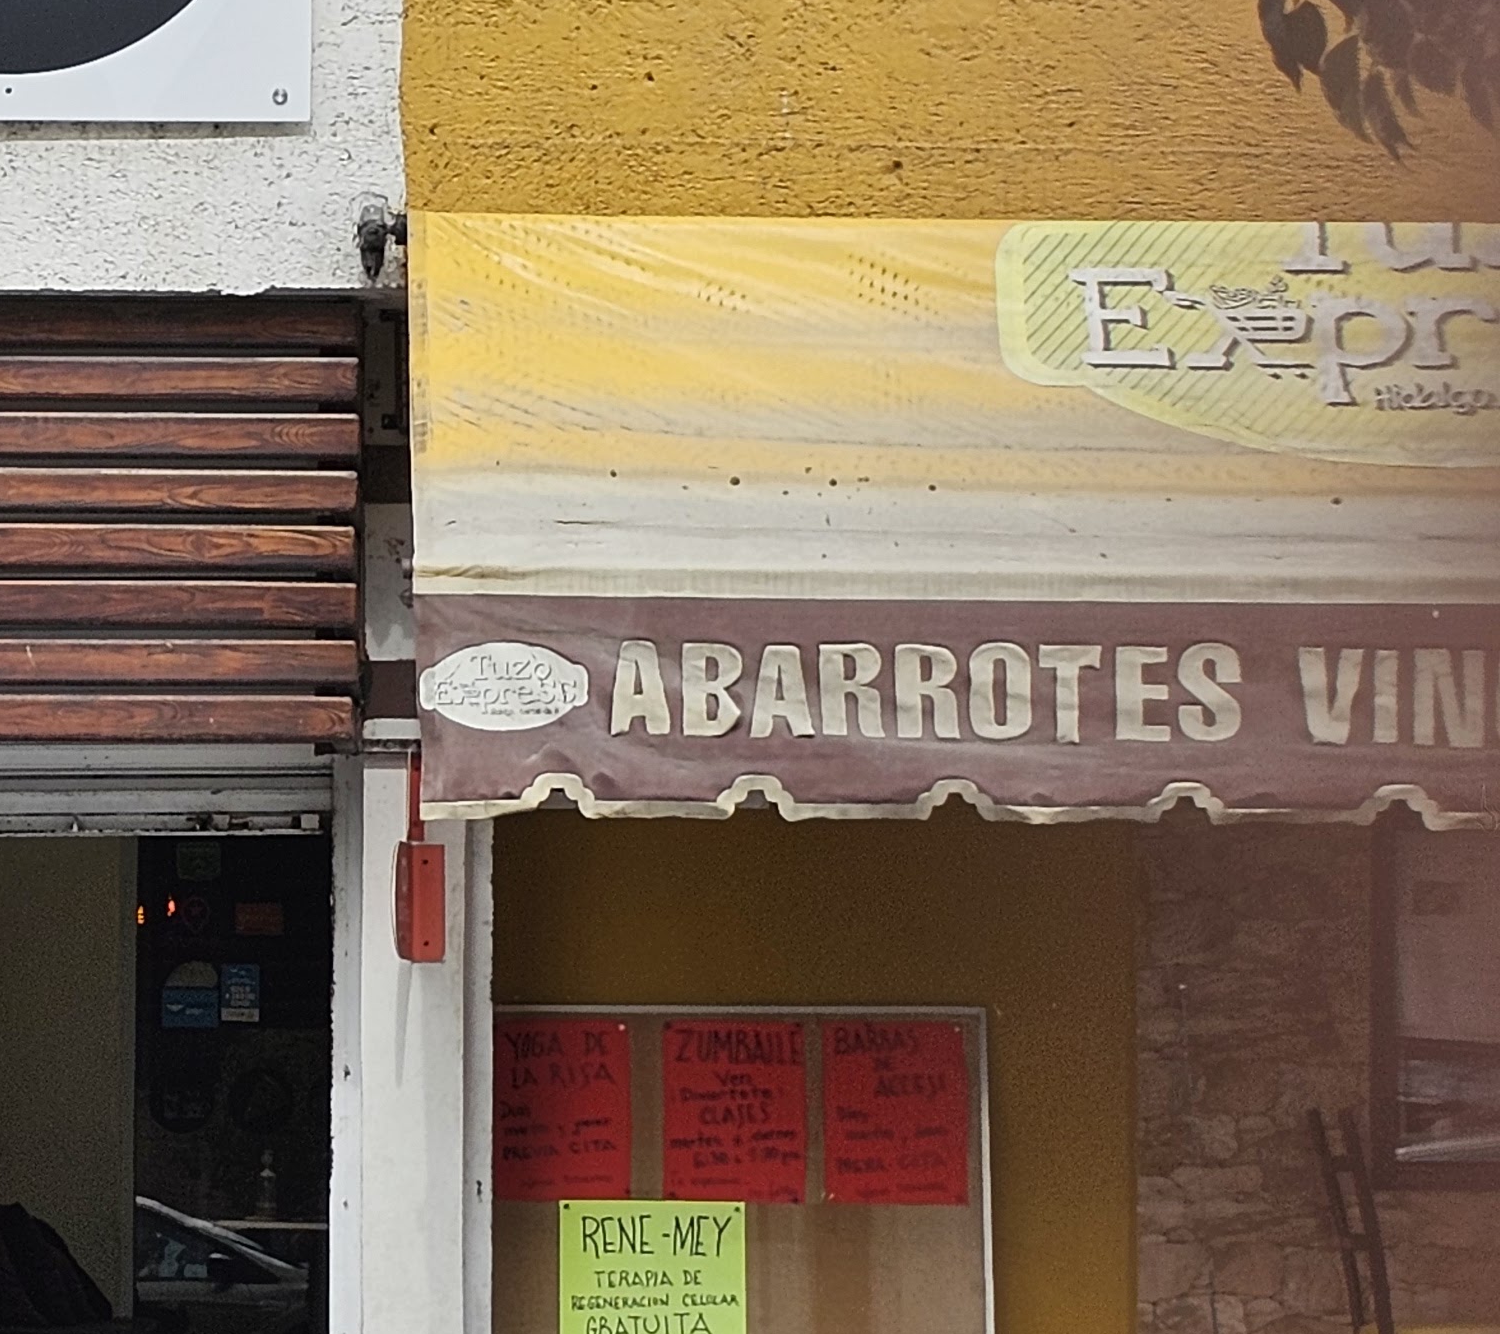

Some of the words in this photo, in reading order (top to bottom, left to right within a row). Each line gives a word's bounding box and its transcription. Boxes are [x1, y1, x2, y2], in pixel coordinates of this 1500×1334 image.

[608, 638, 1242, 746] ABARROTES
[1299, 646, 1500, 749] VIN
[581, 1215, 654, 1259] RENE
[594, 1270, 673, 1288] TERAPIA
[683, 1269, 703, 1286] DE
